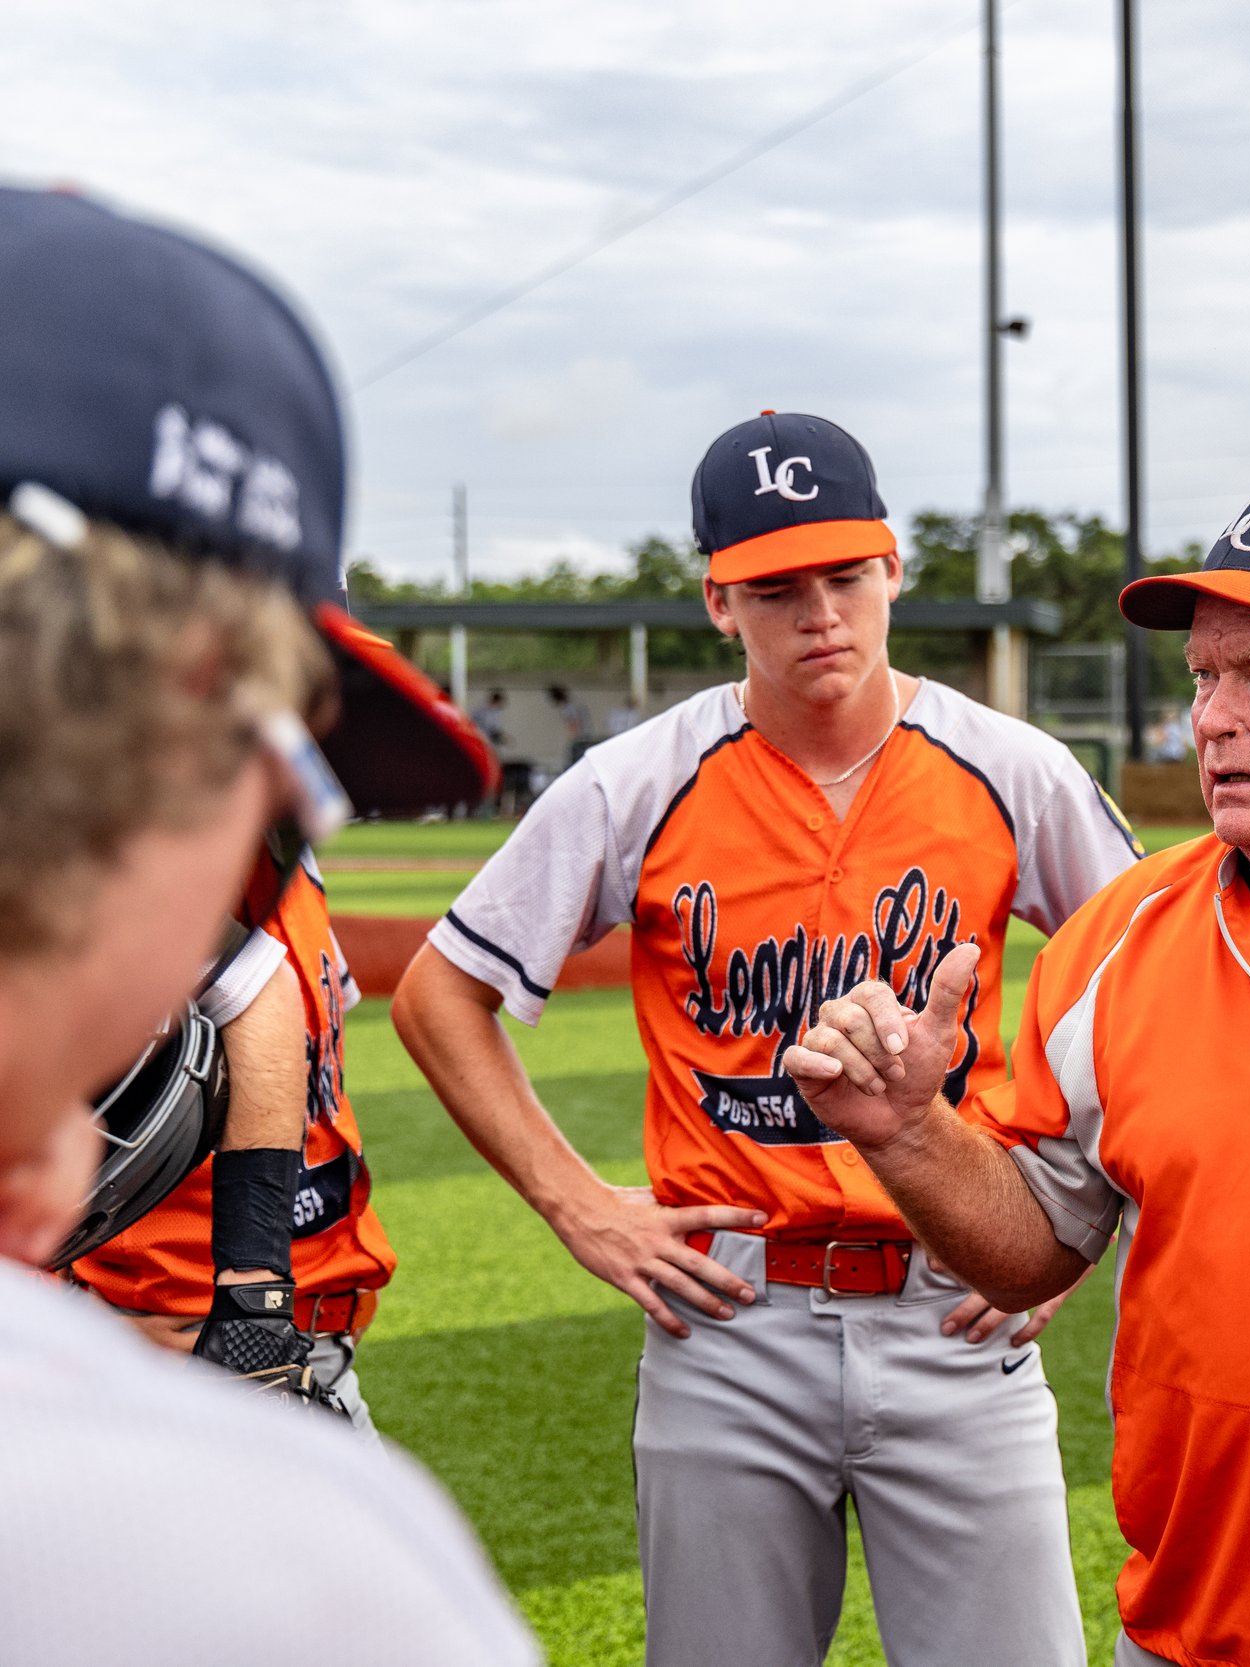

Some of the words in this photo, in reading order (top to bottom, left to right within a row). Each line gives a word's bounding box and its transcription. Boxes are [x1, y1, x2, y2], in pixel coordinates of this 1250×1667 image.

[747, 445, 819, 502] LC
[717, 1091, 760, 1127] POST
[757, 1095, 797, 1128] 554
